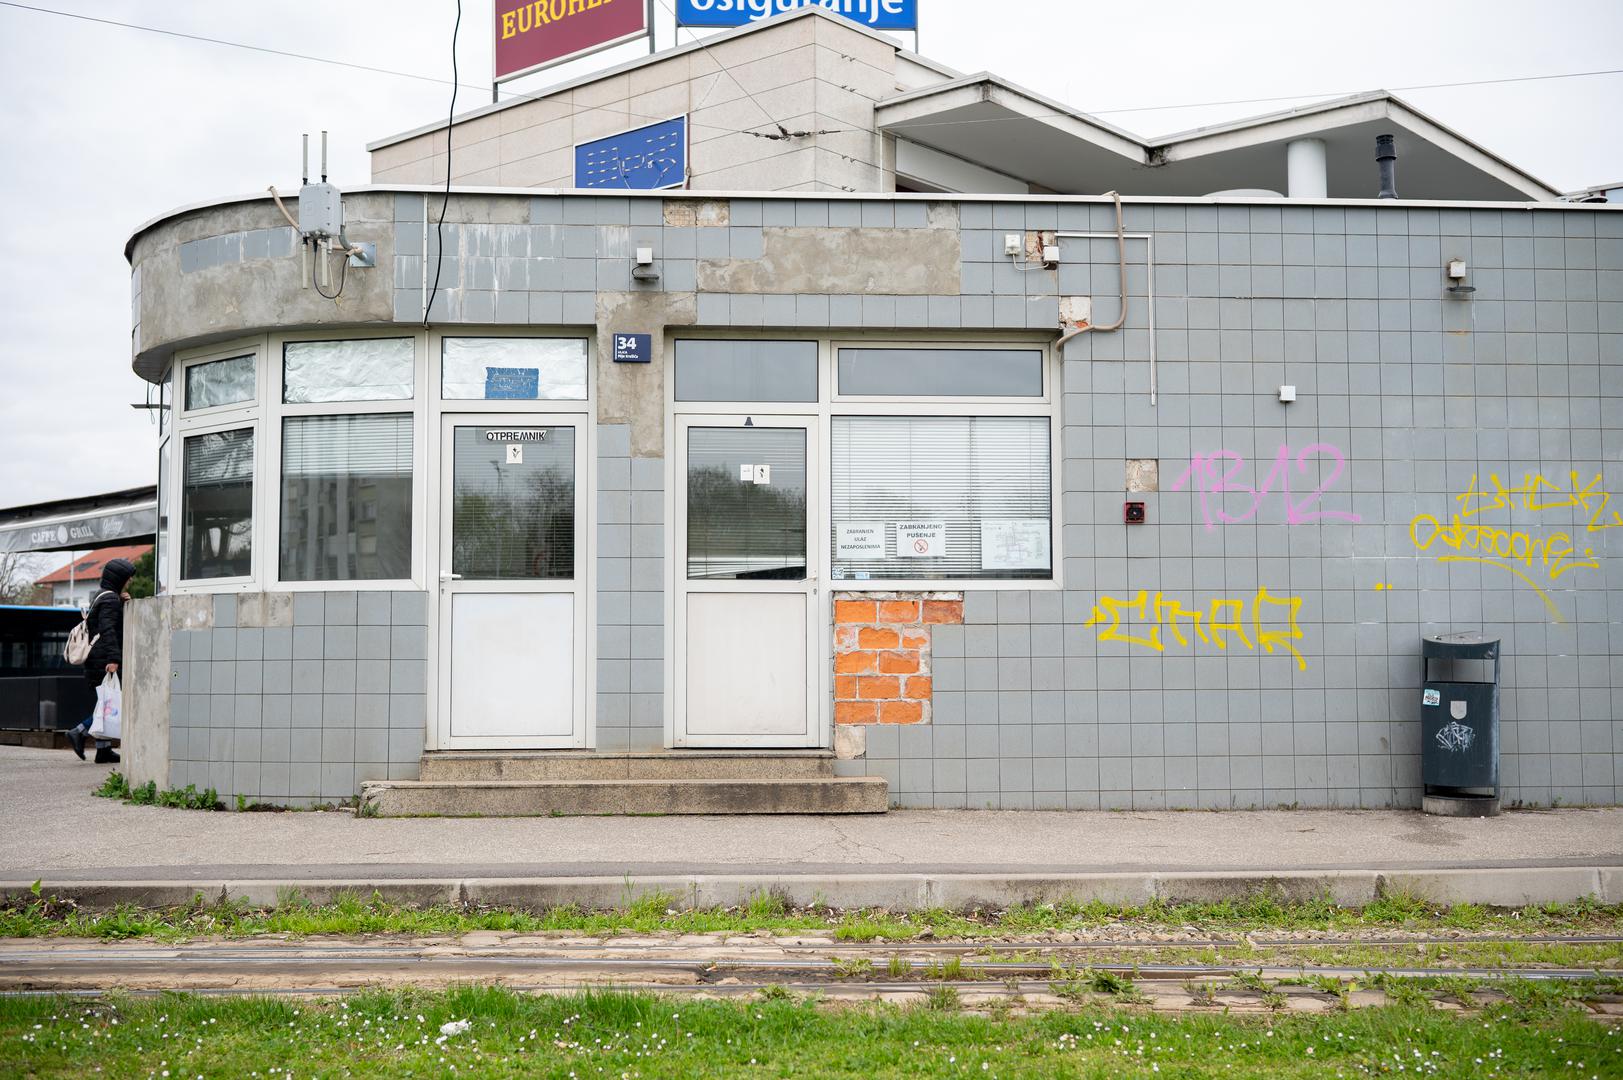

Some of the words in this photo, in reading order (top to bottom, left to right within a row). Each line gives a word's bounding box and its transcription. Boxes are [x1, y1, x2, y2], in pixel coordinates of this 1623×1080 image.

[617, 337, 637, 350] 34
[486, 431, 545, 441] OTPREMNIK
[1171, 443, 1361, 534] 1312
[70, 526, 94, 539] GRILL
